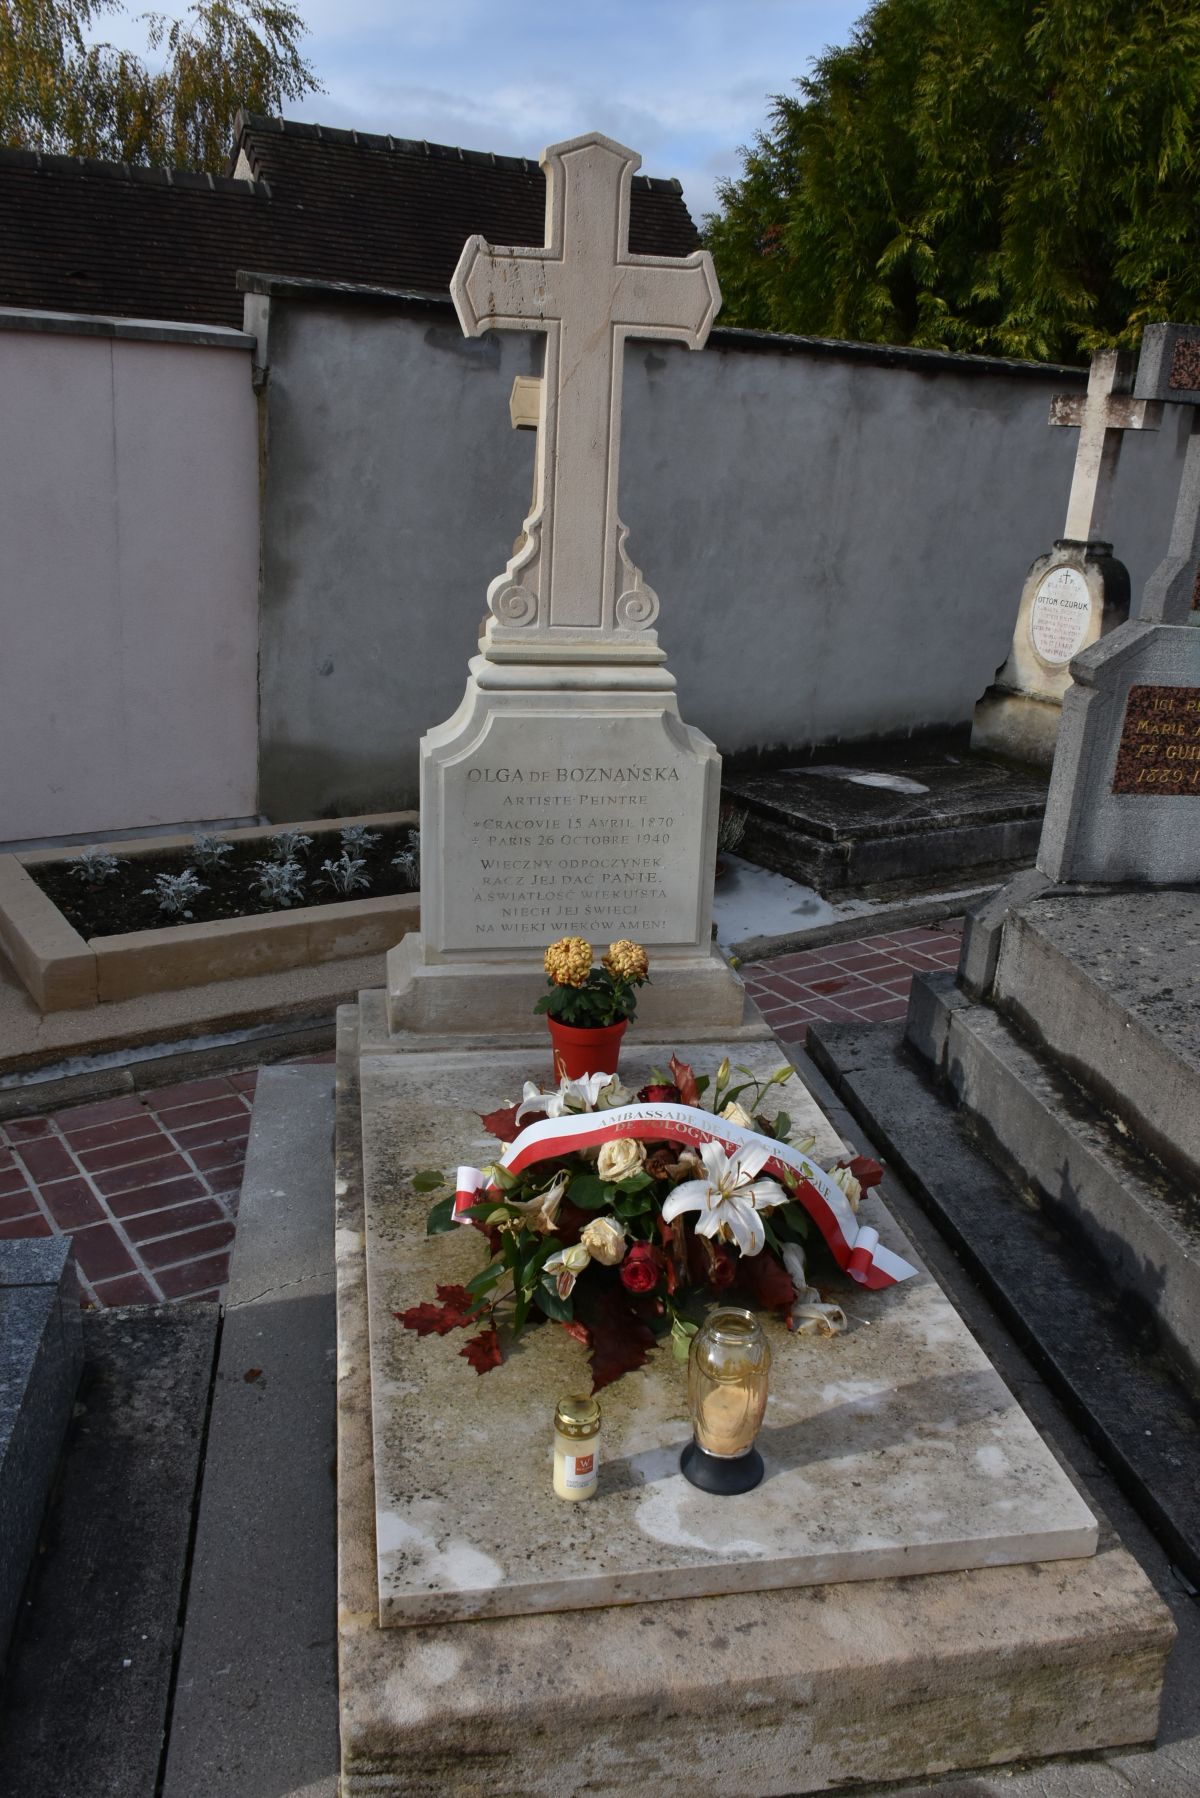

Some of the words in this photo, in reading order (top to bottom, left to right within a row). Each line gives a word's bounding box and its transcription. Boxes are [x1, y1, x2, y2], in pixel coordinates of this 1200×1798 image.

[1154, 699, 1175, 711] ICI
[1136, 719, 1185, 736] MARIE
[467, 768, 524, 782] OLGA
[529, 772, 551, 782] DE
[557, 763, 680, 782] BOZNAŃSKA
[1137, 768, 1183, 783] 1889
[568, 818, 582, 829] 15
[588, 818, 634, 828] AVRIL
[641, 817, 674, 828] 1870
[488, 836, 532, 847] PARIS
[538, 834, 554, 846] 26
[561, 834, 632, 846] OCTOBRE
[638, 833, 670, 844] 1940
[480, 859, 553, 870] WIECZNY
[559, 858, 662, 868] ODPOCZYNEK
[482, 876, 525, 886] RACZ
[531, 875, 555, 885] JEJ
[562, 873, 594, 884] DAĆ
[474, 894, 482, 902] A
[502, 907, 550, 918] NIECH
[556, 906, 578, 916] JEJ
[476, 924, 495, 933] NA
[501, 923, 545, 932] WIEKI
[550, 920, 614, 932] WIEKÓW
[618, 920, 666, 930] AMEN!
[599, 1110, 697, 1126] AMBASSADE
[615, 1120, 636, 1132] DE
